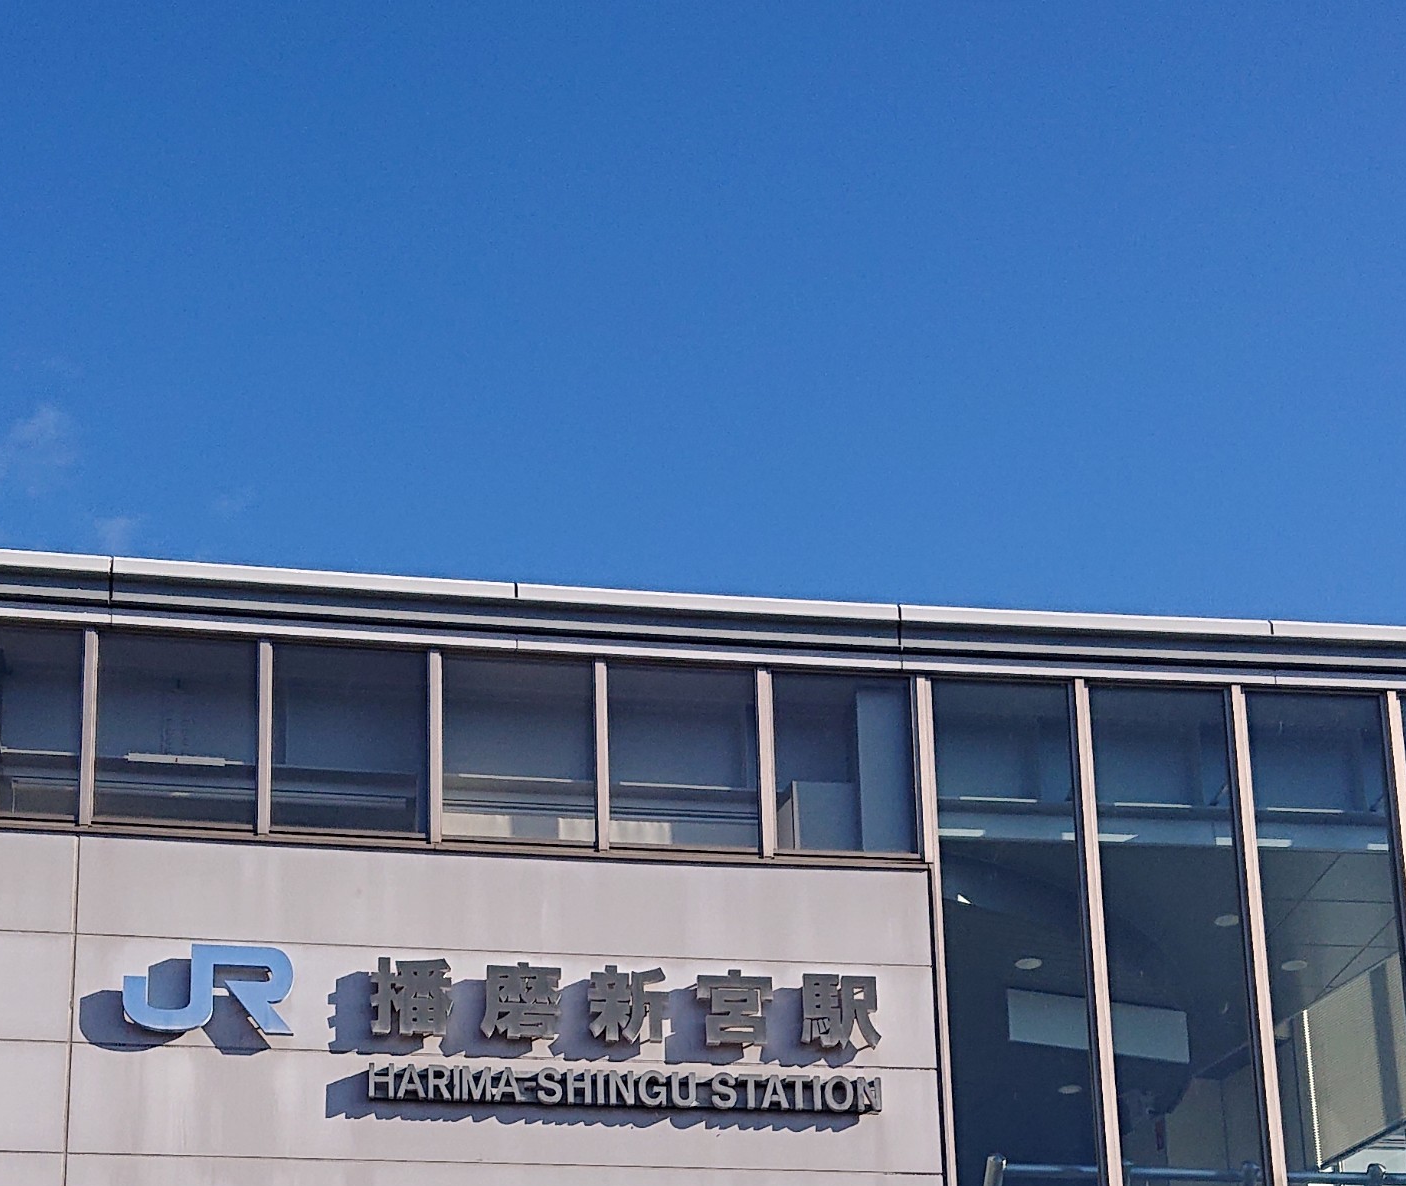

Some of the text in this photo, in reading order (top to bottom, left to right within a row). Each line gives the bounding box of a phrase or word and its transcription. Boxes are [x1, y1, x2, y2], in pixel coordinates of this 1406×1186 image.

[122, 943, 294, 1036] JR
[371, 957, 882, 1050] 播磨新宮駅
[368, 1063, 882, 1113] HARIMA-SHINGU STATION
